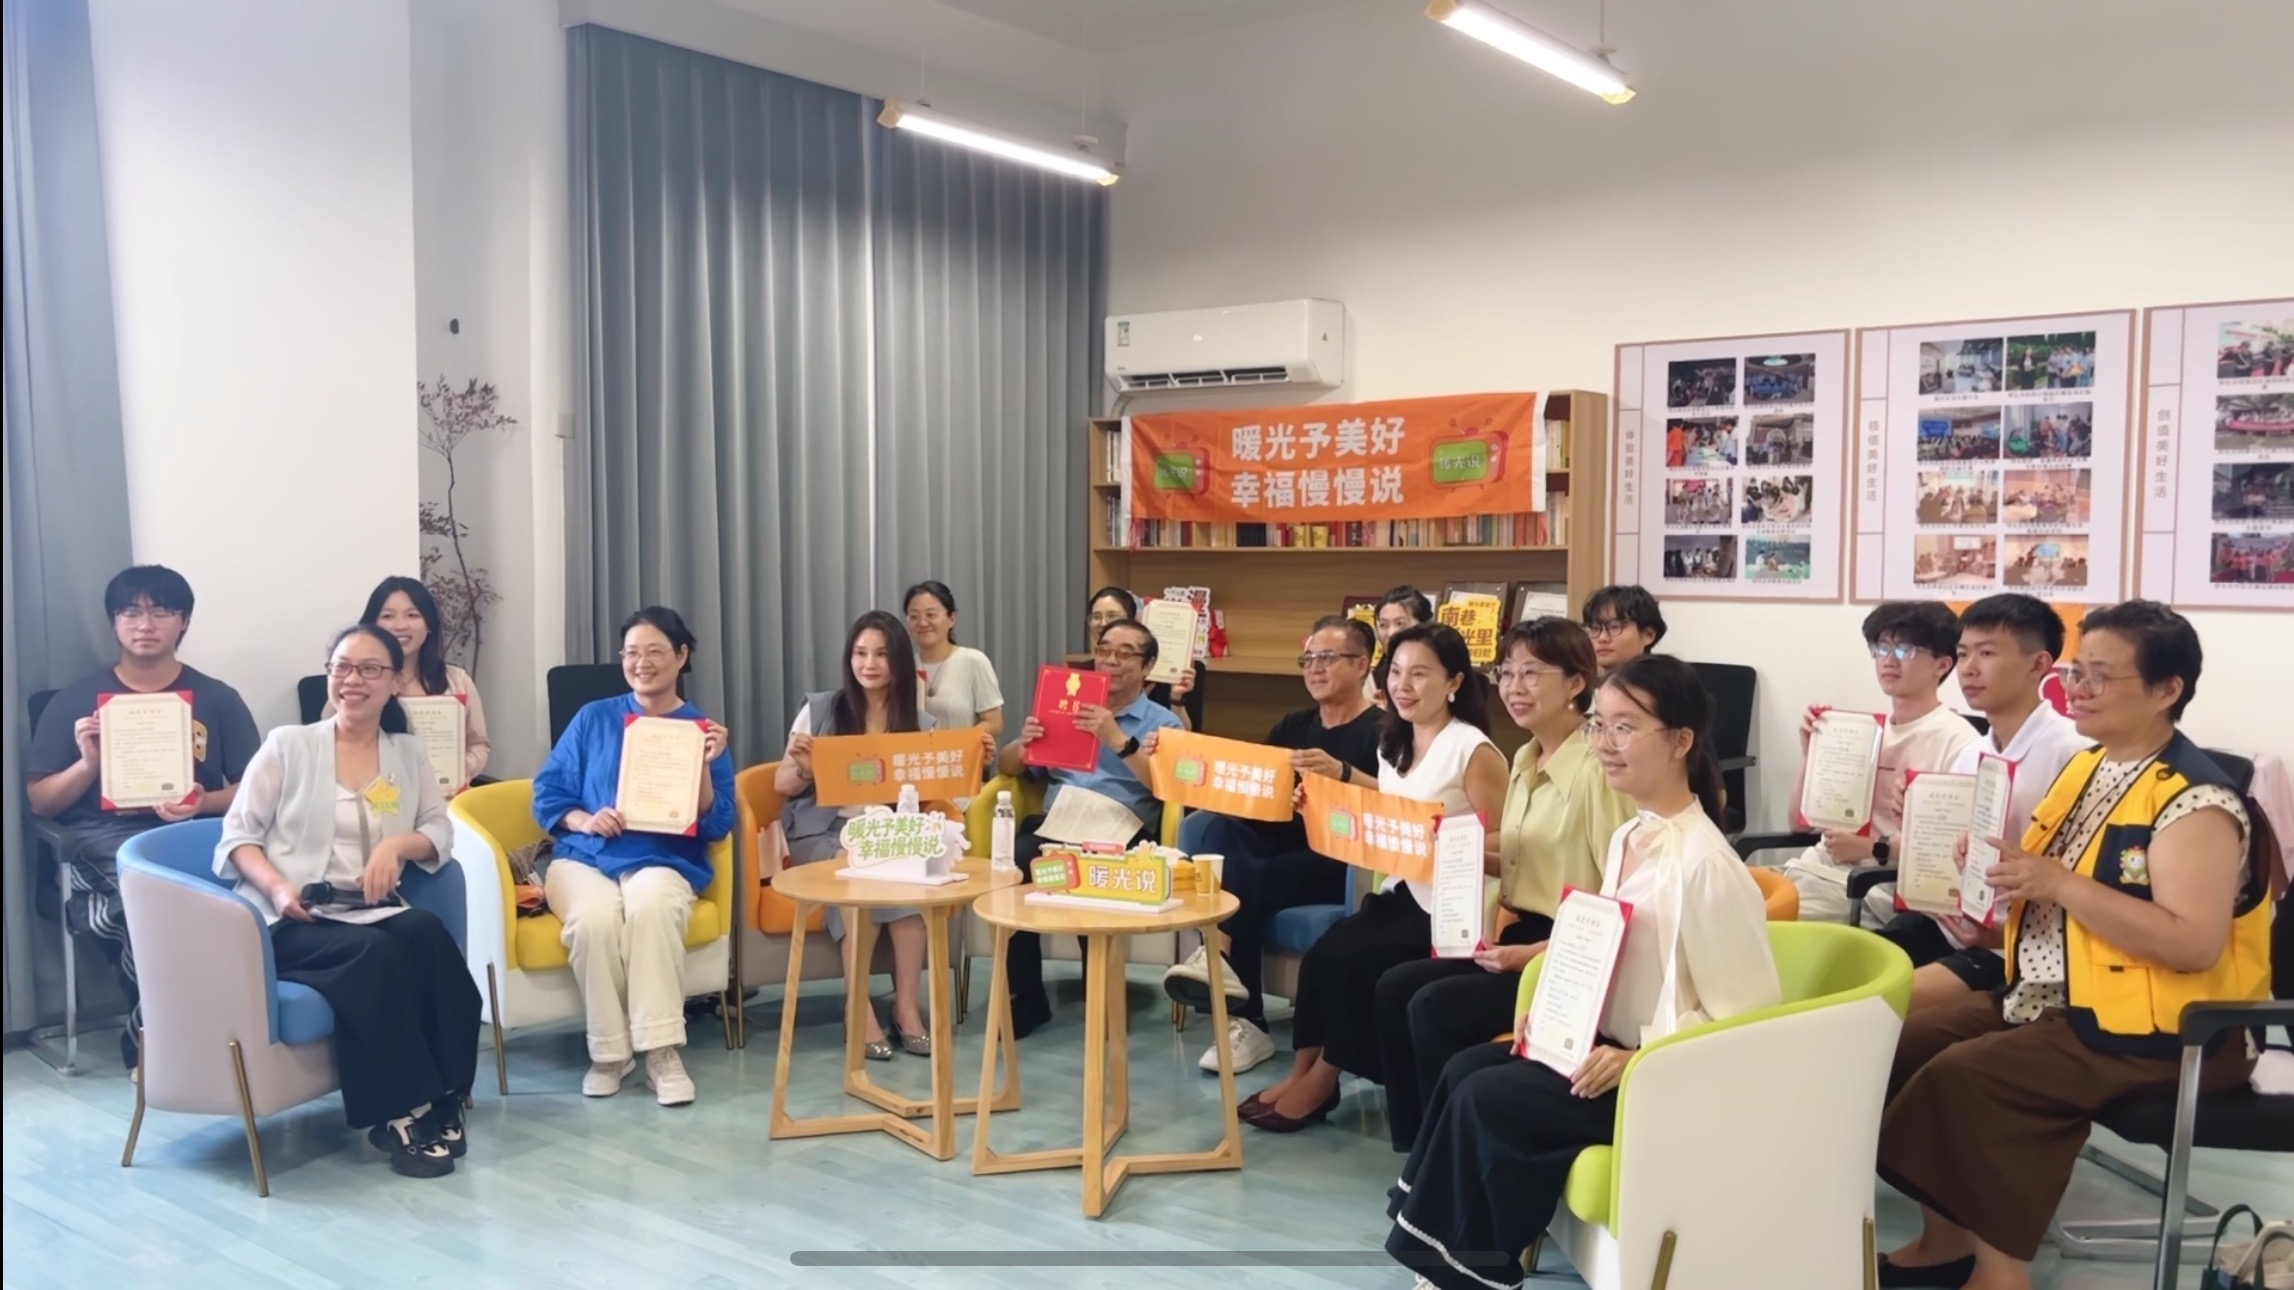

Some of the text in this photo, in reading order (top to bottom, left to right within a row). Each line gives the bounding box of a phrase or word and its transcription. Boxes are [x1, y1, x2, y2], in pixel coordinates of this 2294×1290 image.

[1231, 416, 1405, 462] 暖光予美好
[1623, 430, 1635, 505] 体验美好生活
[1230, 465, 1405, 509] 幸福慢慢说
[1441, 606, 1477, 627] 南巷
[892, 748, 964, 768] 暖光予美好
[1213, 759, 1277, 783] 暖光予美好
[893, 764, 964, 782] 幸福慢慢说
[1212, 774, 1276, 800] 幸福慢慢说
[847, 816, 925, 841] 暖光予美好
[1362, 811, 1426, 839] 暖光予美好
[858, 834, 944, 860] 幸福慢慢说
[1363, 830, 1428, 858] 幸福慢慢说
[1088, 865, 1158, 894] 暖光说
